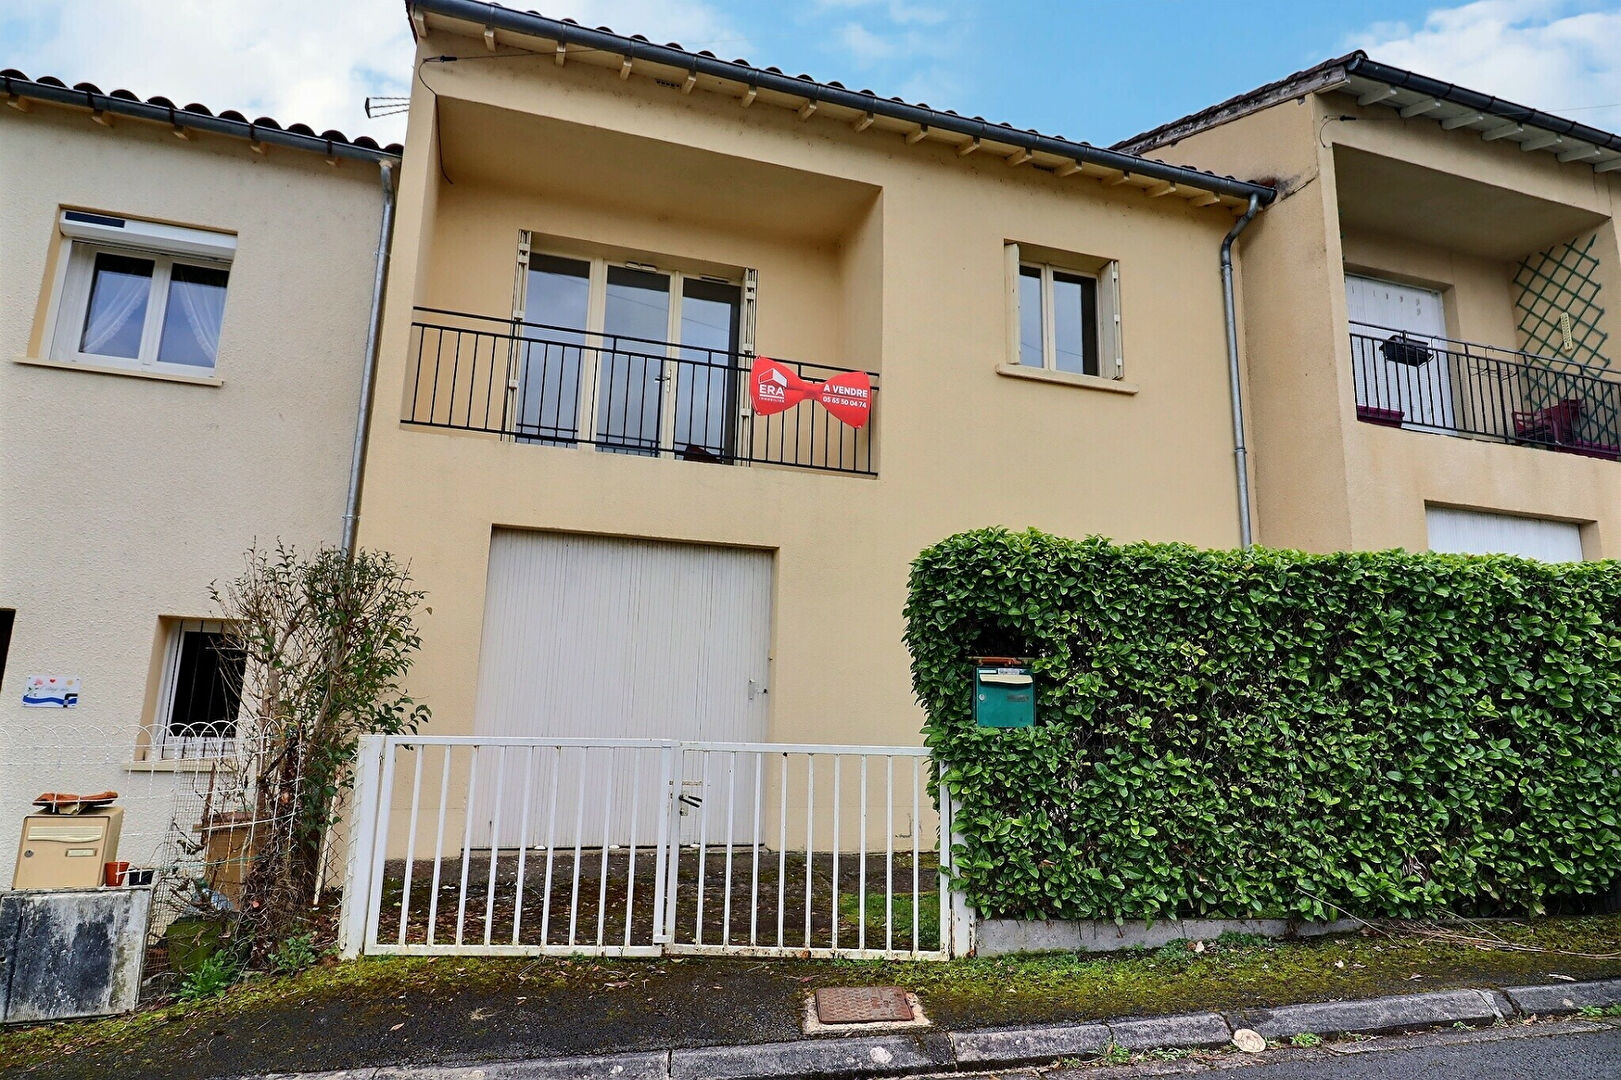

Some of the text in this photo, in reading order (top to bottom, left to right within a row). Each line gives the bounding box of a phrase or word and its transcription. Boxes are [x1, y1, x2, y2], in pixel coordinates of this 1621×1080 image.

[759, 384, 784, 397] ERA
[823, 384, 868, 398] A VENDRE
[840, 398, 849, 406] 50
[858, 401, 867, 409] 74
